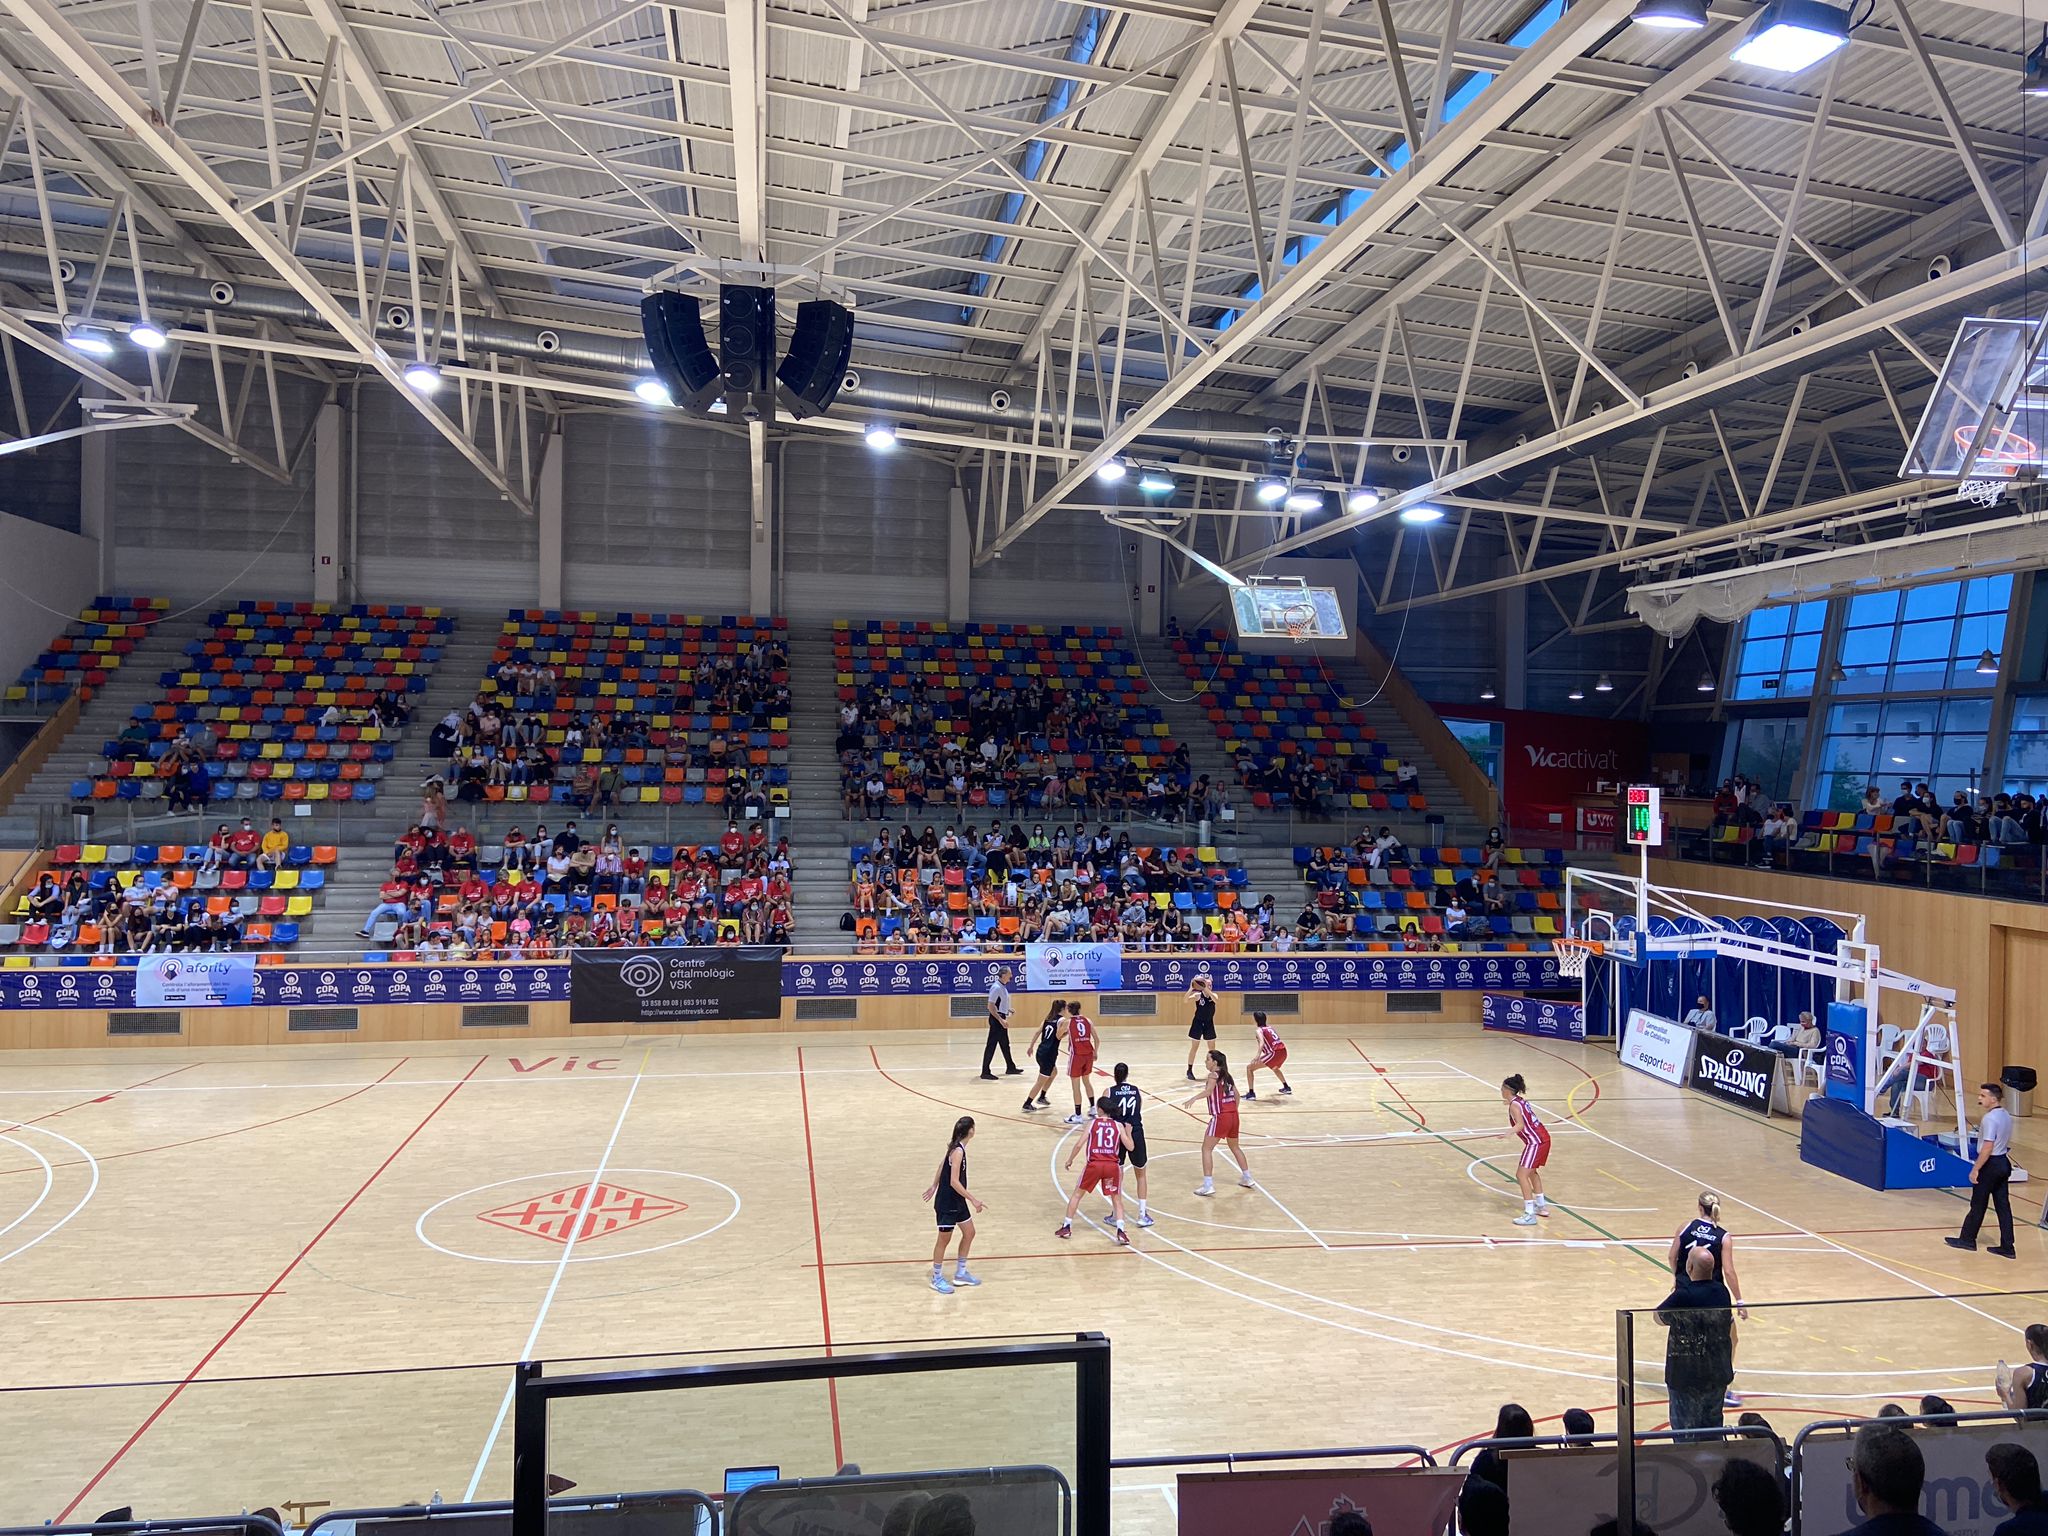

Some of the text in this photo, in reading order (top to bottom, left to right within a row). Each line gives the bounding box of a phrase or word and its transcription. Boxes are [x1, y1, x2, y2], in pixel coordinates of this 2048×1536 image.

[1066, 950, 1102, 962] afority
[670, 958, 705, 968] Centre
[186, 963, 231, 975] afority
[670, 968, 735, 980] oftalmològic
[1135, 973, 1154, 982] COPA
[1164, 973, 1184, 982] COPA
[1223, 973, 1243, 981] COPA
[1253, 973, 1272, 981] COPA
[1282, 972, 1301, 981] COPA
[1311, 972, 1330, 981] COPA
[1340, 972, 1359, 981] COPA
[1369, 972, 1388, 981] COPA
[1398, 972, 1417, 981] COPA
[1426, 972, 1445, 981] COPA
[1455, 972, 1474, 980] COPA
[1483, 972, 1502, 980] COPA
[1512, 972, 1531, 980] COPA
[1540, 971, 1559, 980] COPA
[795, 977, 816, 986] COPA
[827, 977, 848, 986] COPA
[859, 977, 880, 985] COPA
[891, 976, 911, 985] COPA
[922, 975, 942, 984] COPA
[953, 975, 973, 984] COPA
[984, 975, 1000, 984] COP
[352, 984, 375, 994] COPA
[388, 984, 411, 993] COPA
[424, 983, 447, 993] COPA
[459, 983, 482, 992] COPA
[494, 982, 517, 992] COPA
[529, 982, 552, 991] COPA
[670, 980, 692, 990] VSK
[18, 988, 42, 998] COPA
[56, 989, 80, 998] COPA
[93, 988, 117, 998] COPA
[279, 985, 303, 995] COPA
[316, 985, 339, 995] COPA
[1506, 1012, 1527, 1023] COPA
[1537, 1017, 1558, 1027] COPA
[1076, 1022, 1086, 1037] 9
[1267, 1028, 1279, 1040] 3
[508, 1056, 622, 1073] Vic
[1639, 1052, 1676, 1074] esportcat
[1830, 1055, 1851, 1070] COPA
[1699, 1054, 1767, 1099] SPALDING
[1118, 1095, 1137, 1117] 19
[1095, 1126, 1115, 1148] 13
